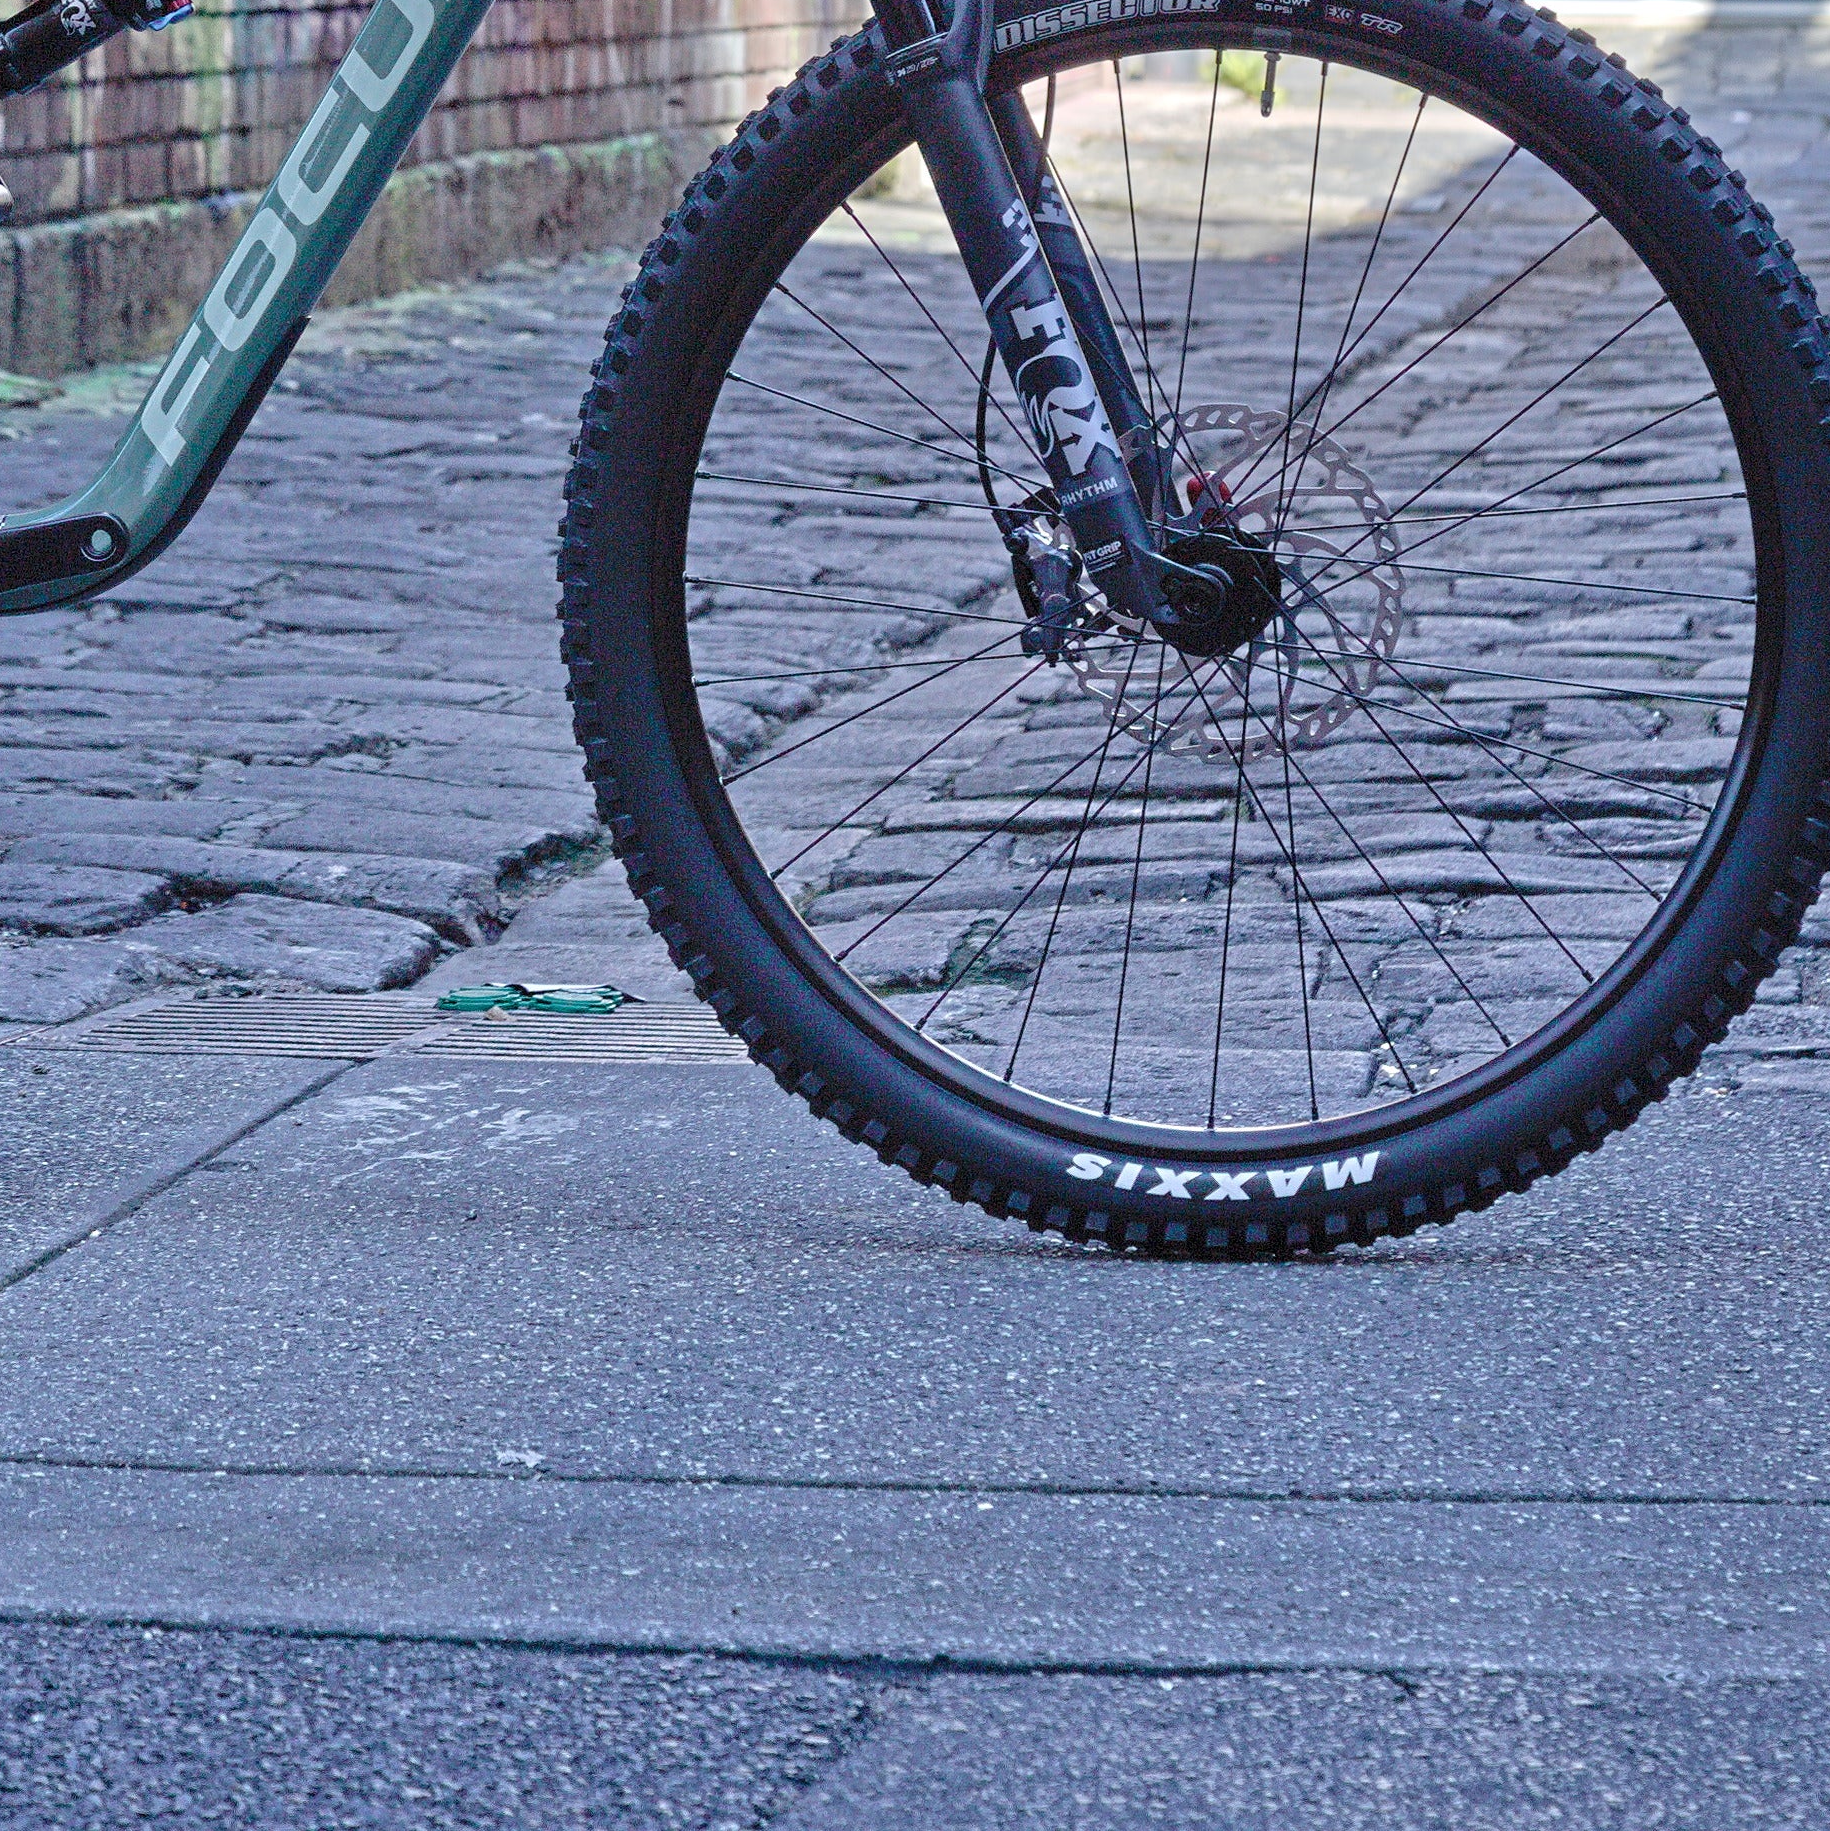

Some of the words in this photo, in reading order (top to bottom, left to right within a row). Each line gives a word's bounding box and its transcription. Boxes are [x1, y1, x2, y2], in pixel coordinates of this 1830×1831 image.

[1254, 2, 1272, 12] 50
[1273, 4, 1293, 15] PSI
[1360, 12, 1404, 35] TR
[1009, 291, 1124, 478] FOX
[1060, 476, 1119, 506] RHYTHM
[1096, 540, 1122, 560] GRIP
[1065, 1150, 1381, 1201] MAXXIS
